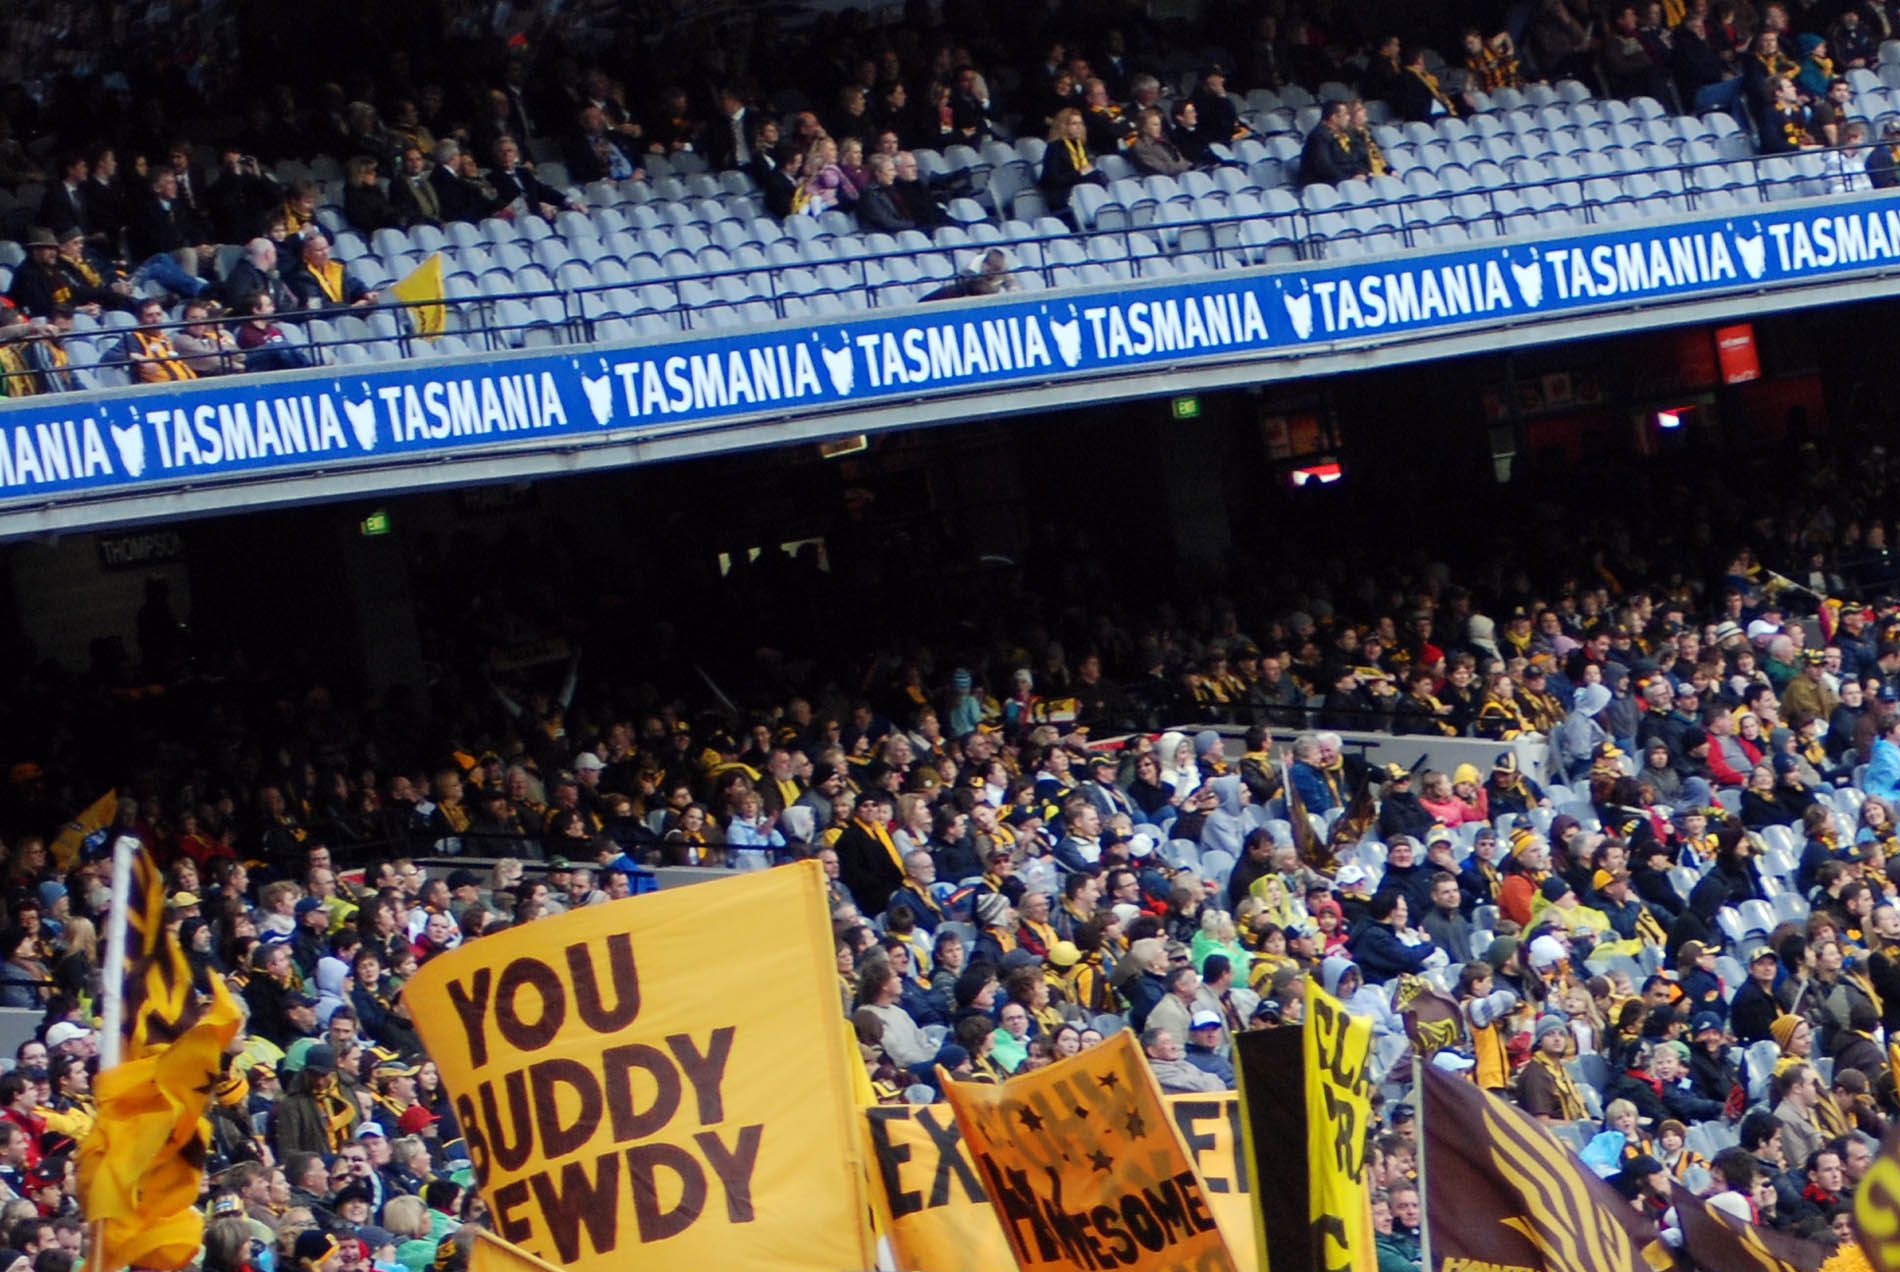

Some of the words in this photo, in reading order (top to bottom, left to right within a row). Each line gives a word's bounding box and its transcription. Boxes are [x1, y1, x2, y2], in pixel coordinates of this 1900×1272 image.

[145, 395, 347, 468] TASMANIA
[378, 370, 567, 441] TASMANIA
[613, 341, 821, 413] TASMANIA
[856, 315, 1052, 383] TASMANIA
[1084, 291, 1267, 355] TASMANIA
[1312, 260, 1513, 327] TASMANIA
[1544, 231, 1738, 298] TASMANIA
[447, 932, 642, 1070] YOU
[456, 1025, 737, 1190] BUDDY
[490, 1124, 765, 1265] EWDY
